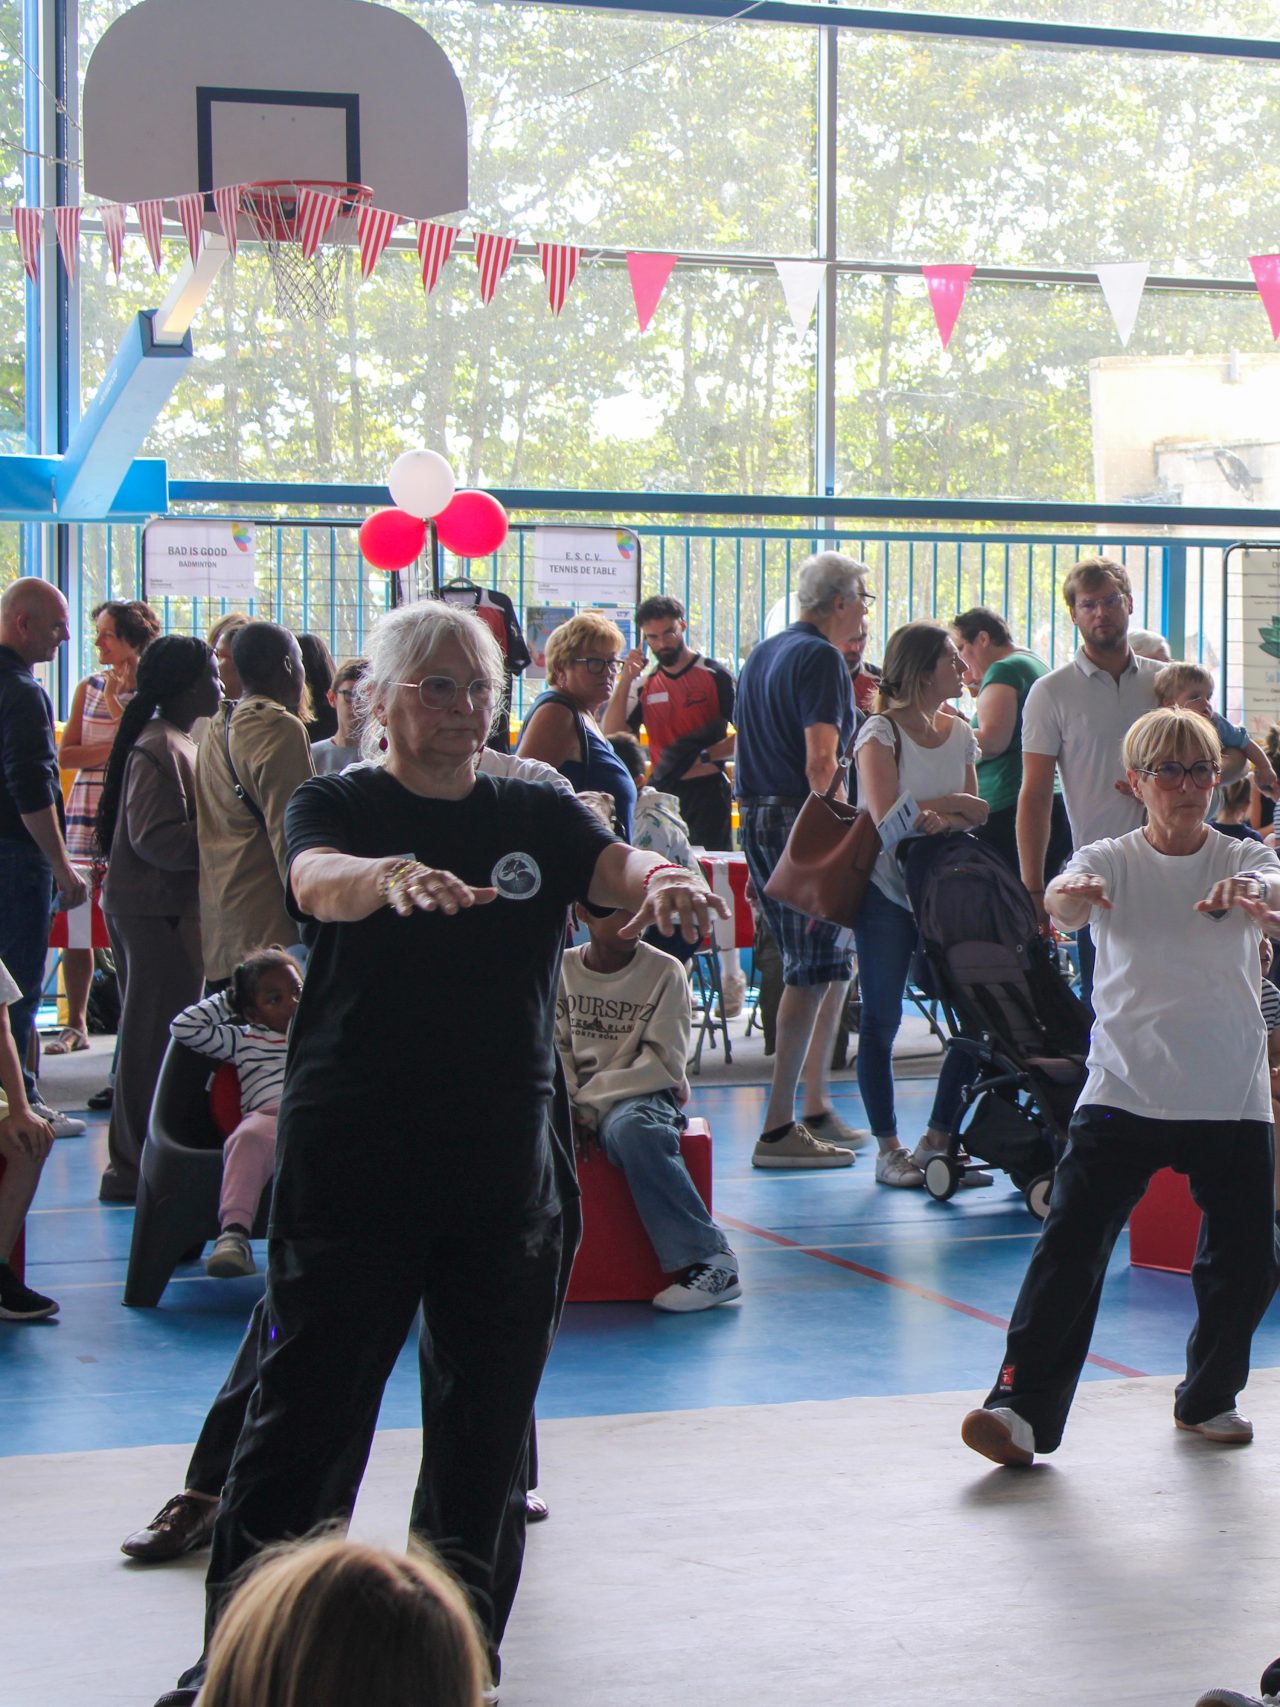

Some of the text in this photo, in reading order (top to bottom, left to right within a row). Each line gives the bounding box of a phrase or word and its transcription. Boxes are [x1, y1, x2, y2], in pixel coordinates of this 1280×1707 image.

[168, 546, 228, 557] BAD IS GOOD
[549, 565, 617, 576] TENNIS DE TABLE
